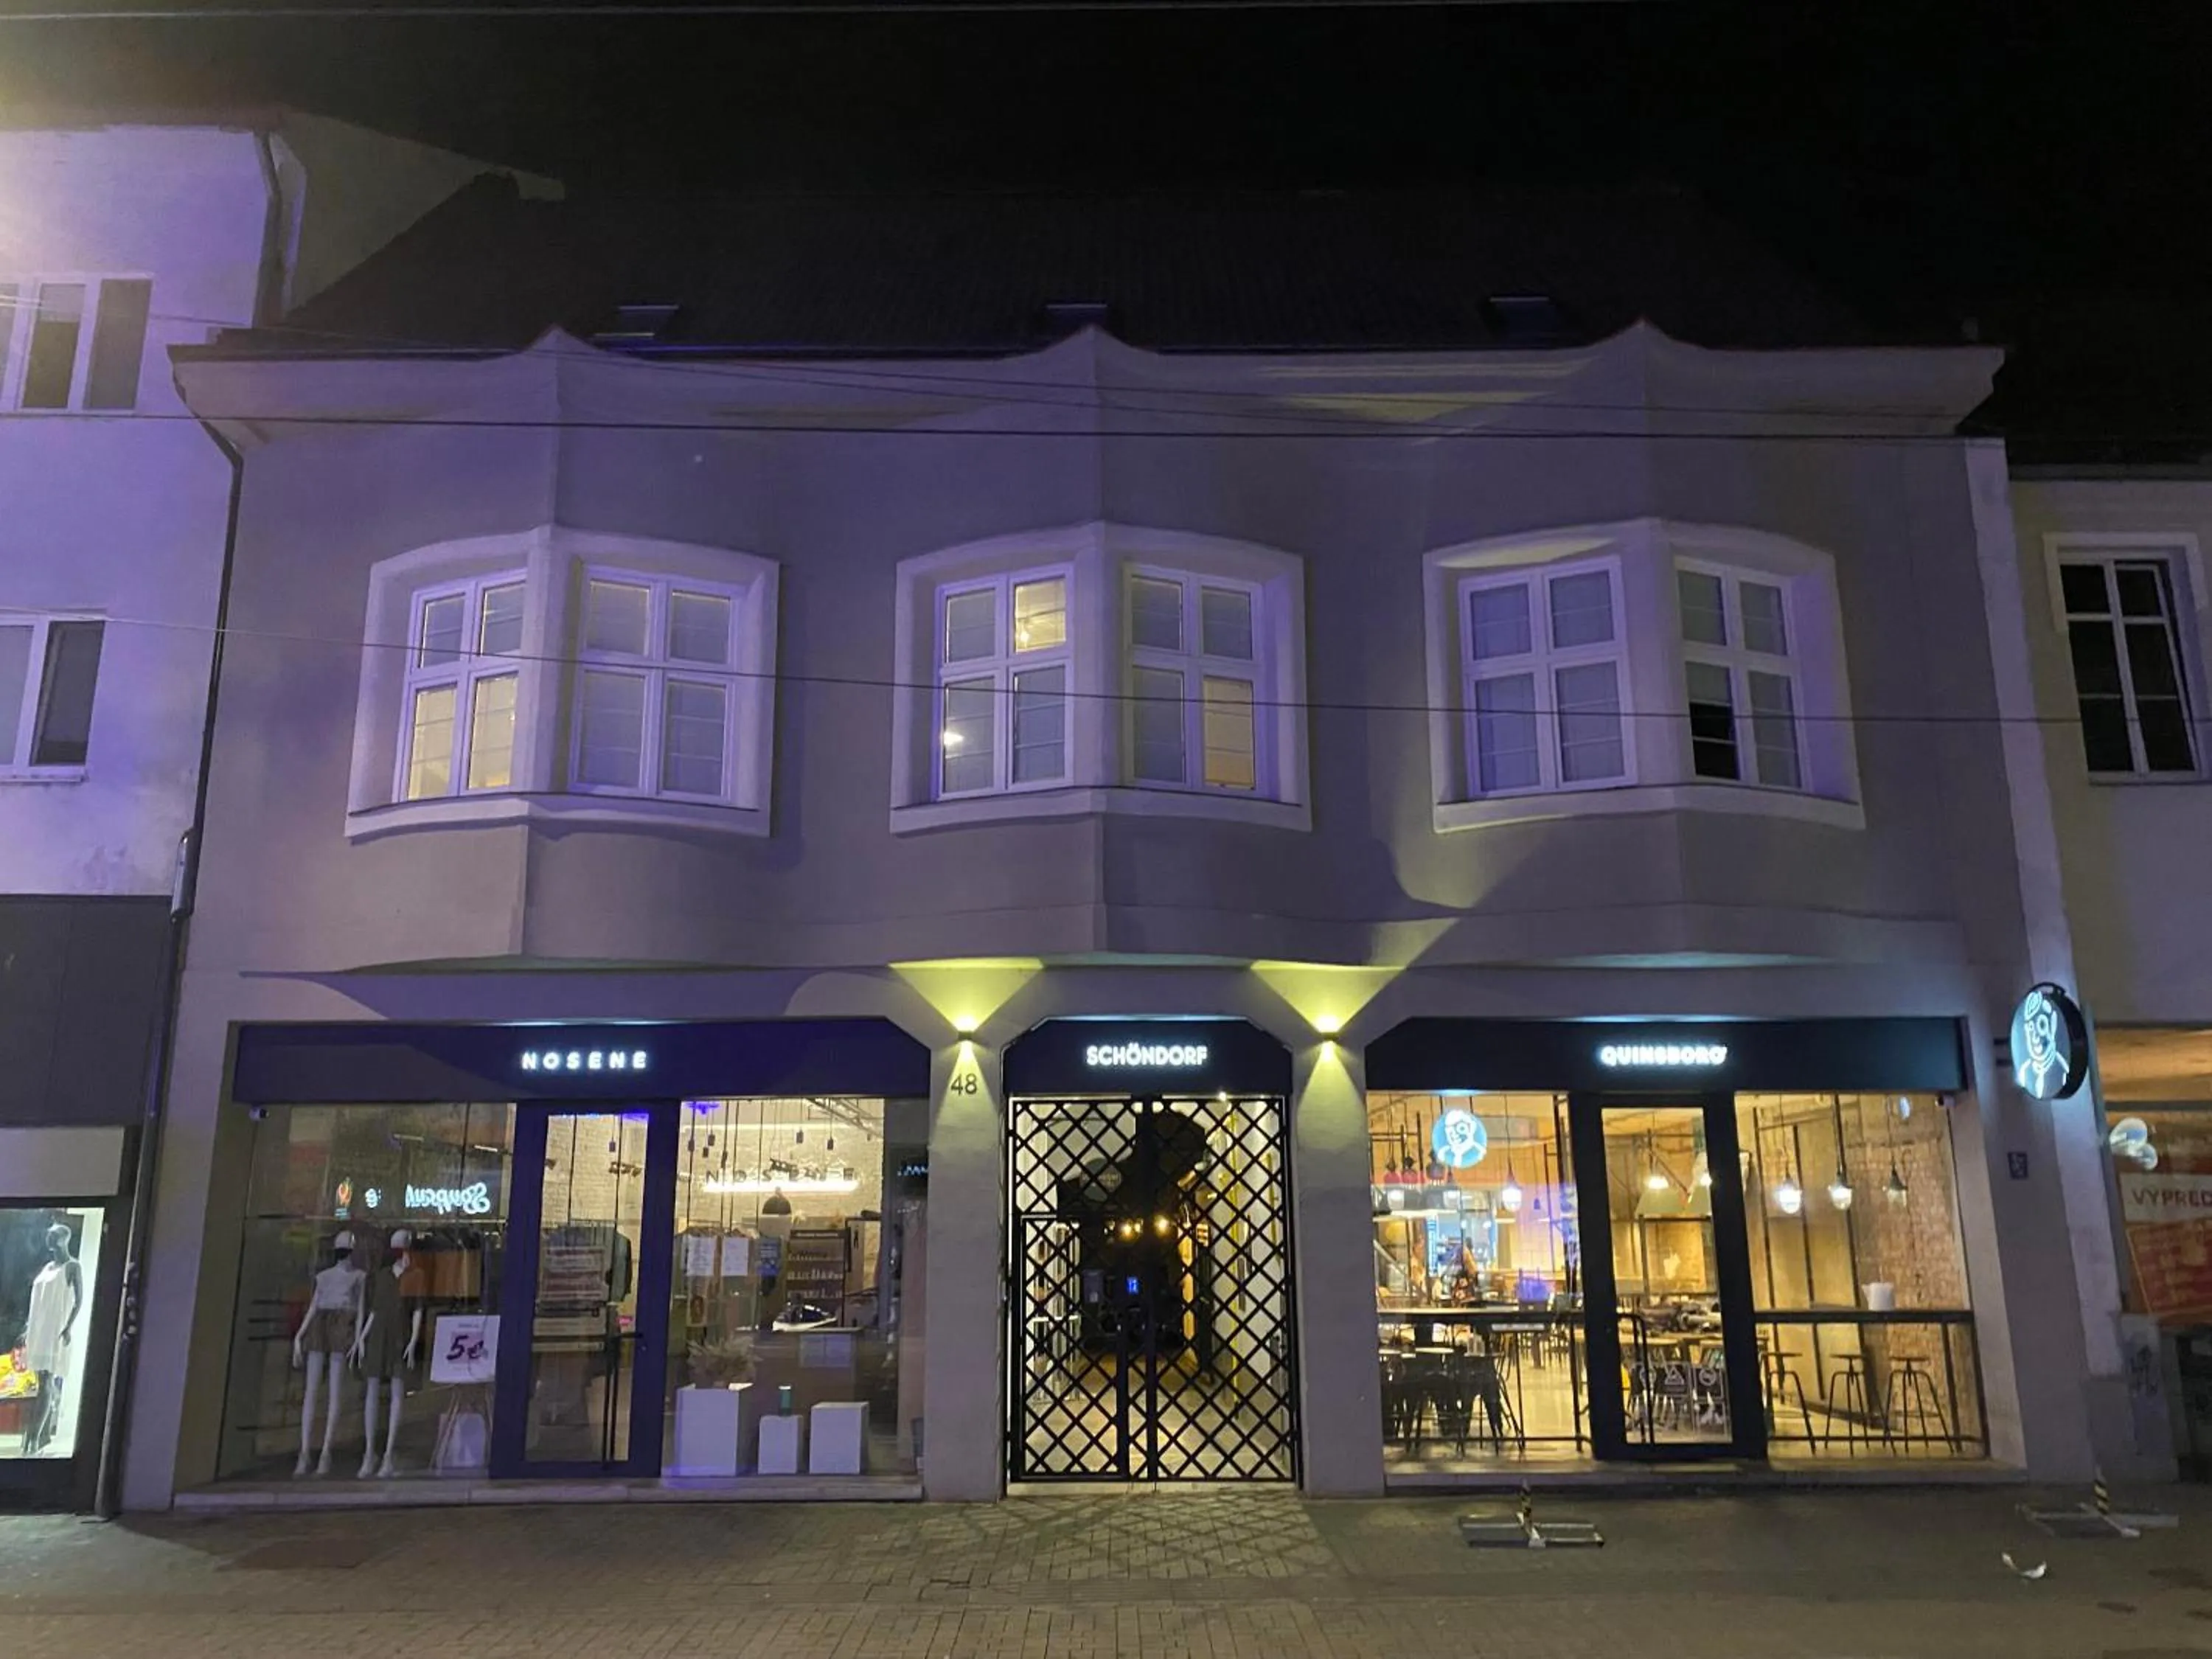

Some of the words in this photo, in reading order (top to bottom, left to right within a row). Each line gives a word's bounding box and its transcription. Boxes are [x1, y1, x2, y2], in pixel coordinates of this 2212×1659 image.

[521, 1050, 647, 1070] NOSENE
[1085, 1043, 1208, 1066] SCHÖNDORF
[950, 1074, 978, 1095] 48
